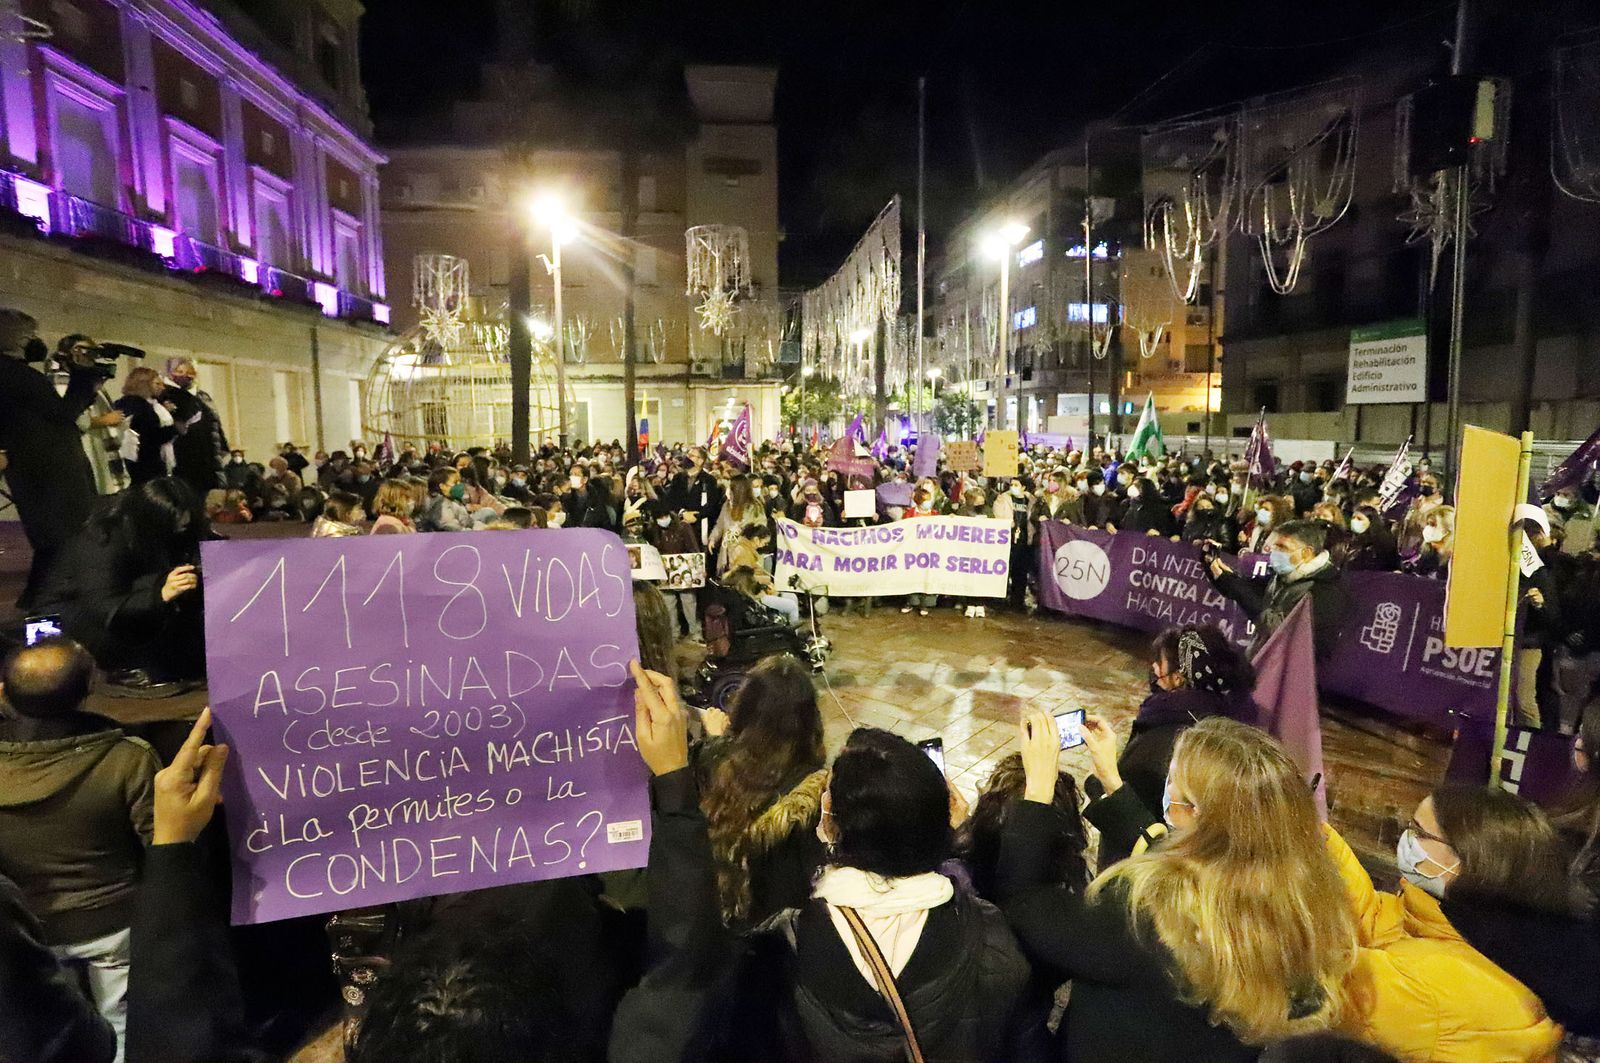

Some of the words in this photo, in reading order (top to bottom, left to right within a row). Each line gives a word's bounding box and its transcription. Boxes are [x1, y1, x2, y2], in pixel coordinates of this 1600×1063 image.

[1353, 356, 1416, 369] Rehabilitación
[1354, 343, 1408, 356] Terminación
[1351, 382, 1418, 393] Administrativo
[1352, 371, 1383, 381] Edificio
[812, 527, 905, 547] NACIMOS
[916, 523, 1009, 545] MUJERES
[776, 547, 824, 572] PARA
[833, 554, 898, 573] MORIR
[904, 552, 941, 570] POR
[945, 555, 1007, 576] SERLO
[1057, 555, 1107, 585] 25N
[230, 544, 488, 657] 1118
[1129, 570, 1198, 602] CONTRA
[1201, 588, 1226, 611] LA
[1126, 591, 1173, 623] HACIA
[1422, 635, 1496, 679] PSOE
[282, 719, 392, 753] (desde
[410, 701, 526, 739] 2003)
[348, 786, 496, 847] permites
[505, 787, 523, 805] o
[285, 810, 604, 899] CONDENAS?
